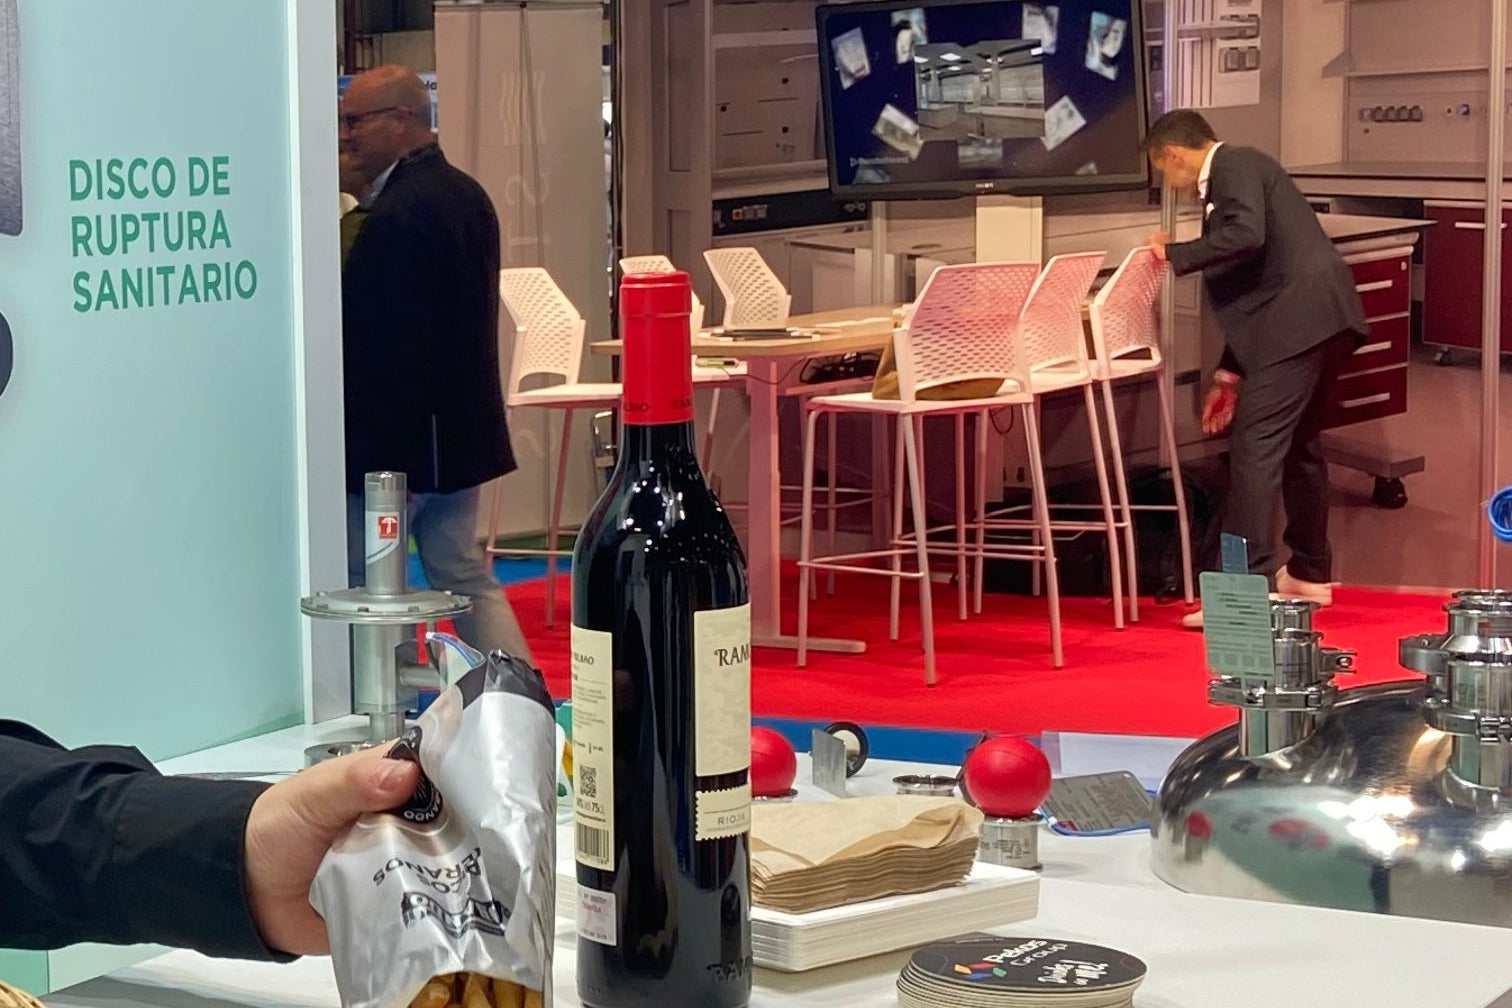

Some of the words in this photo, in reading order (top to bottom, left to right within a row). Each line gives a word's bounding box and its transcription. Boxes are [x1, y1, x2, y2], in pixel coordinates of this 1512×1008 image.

[69, 157, 176, 201] DISCO
[188, 156, 230, 196] DE
[71, 209, 231, 257] RUPTURA
[73, 260, 257, 313] SANITARIO
[982, 940, 1048, 963] Pekos
[1009, 943, 1068, 967] Group
